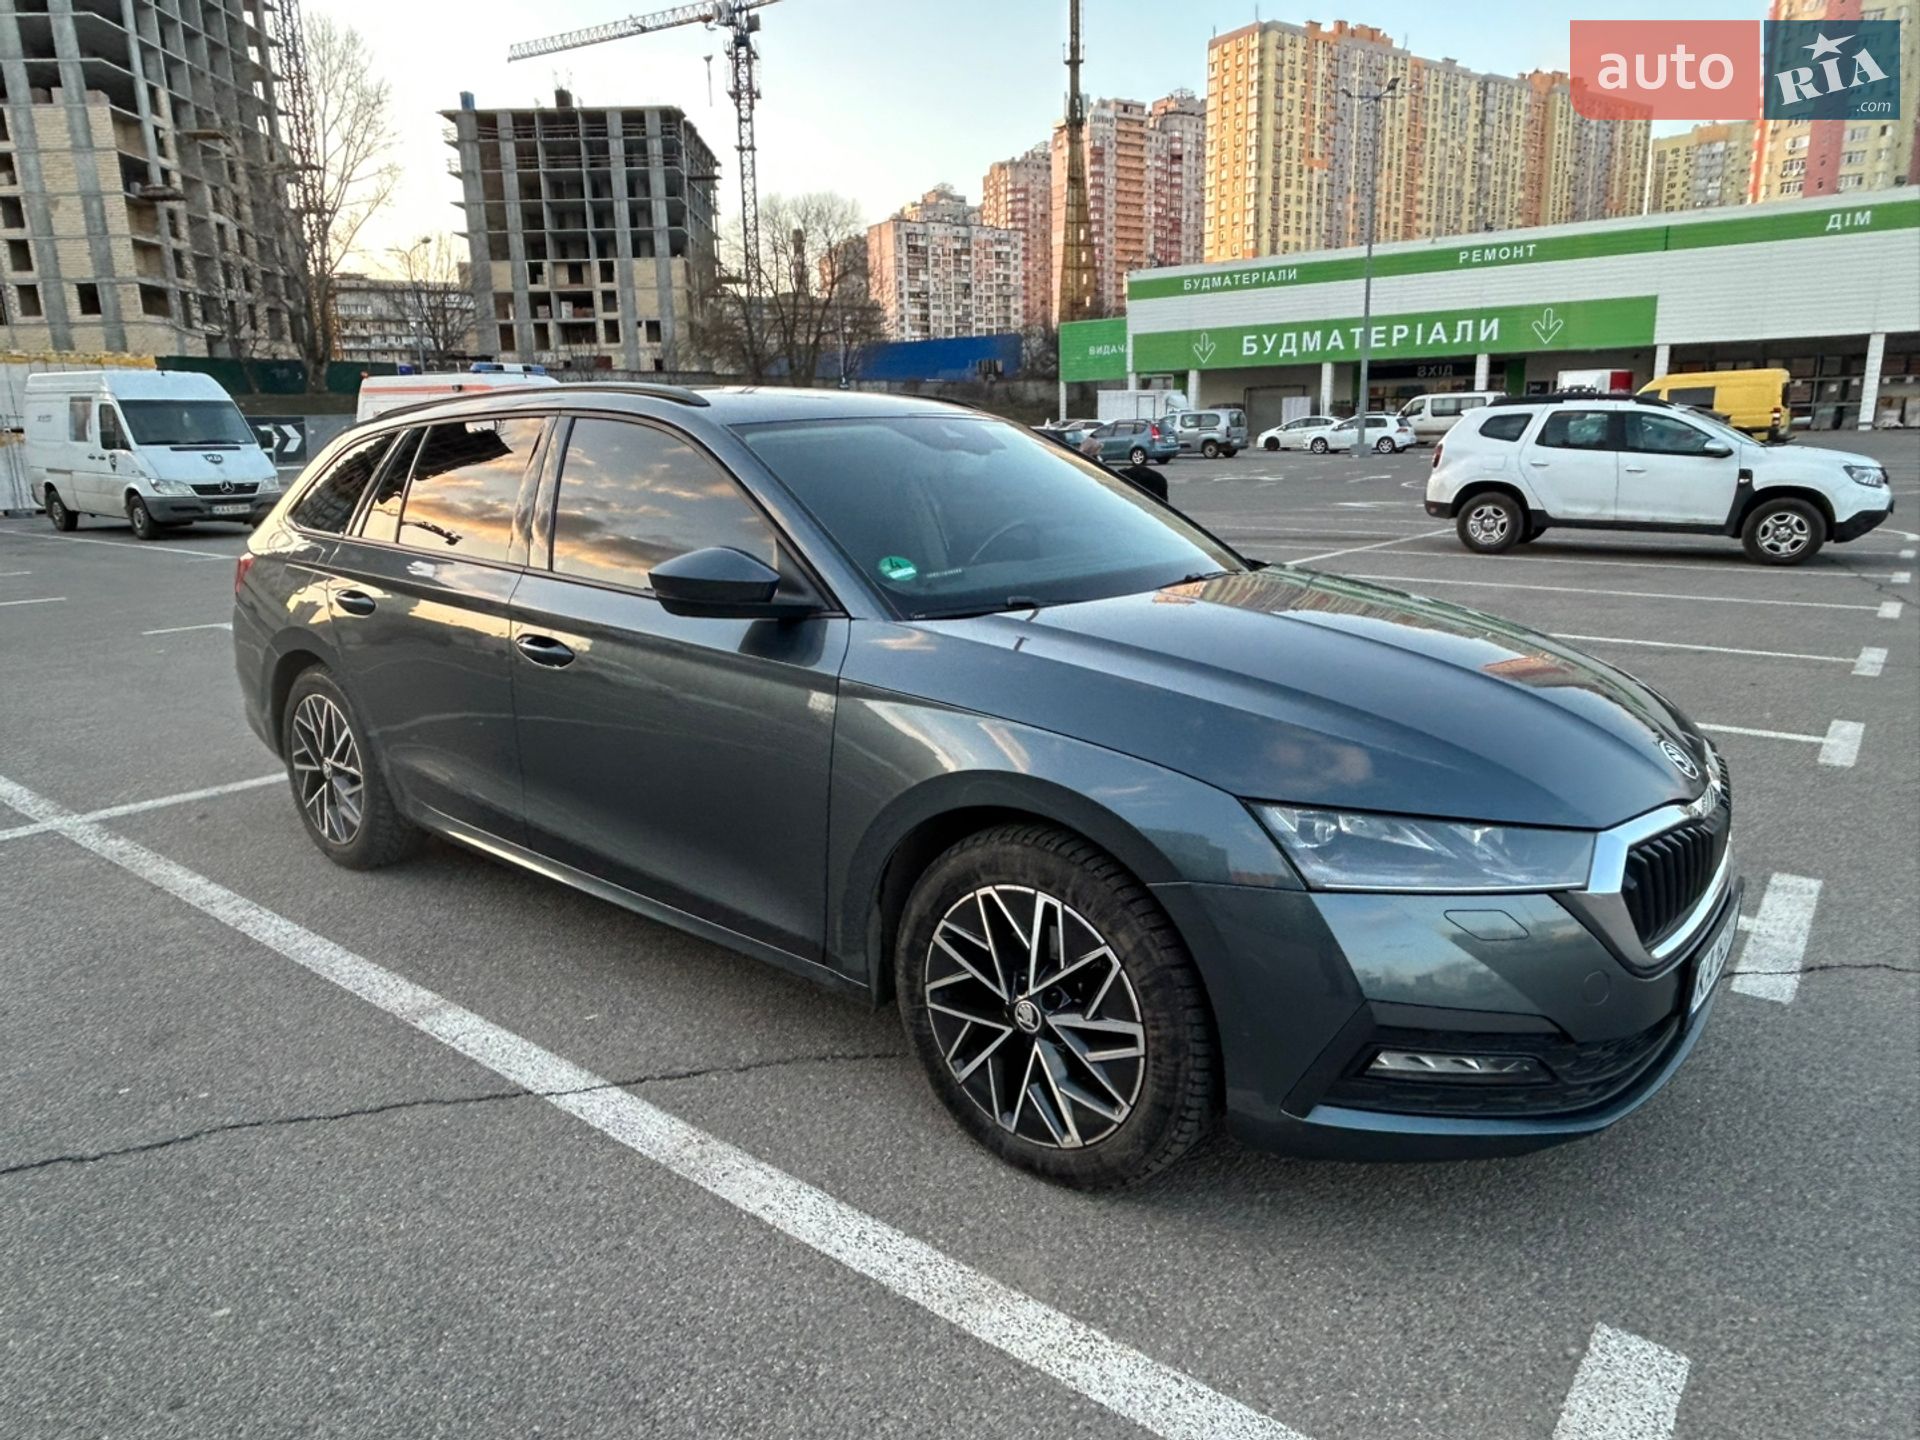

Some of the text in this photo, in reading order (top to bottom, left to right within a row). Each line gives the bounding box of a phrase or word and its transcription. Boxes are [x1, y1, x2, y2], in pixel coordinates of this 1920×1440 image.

[1825, 209, 1872, 232] ДІМ
[1459, 244, 1538, 263] РЕМОНТ
[1183, 268, 1298, 290] БУДМАТЕРІАЛИ
[1242, 317, 1500, 358] БУДМАТЕРІАЛИ
[1088, 344, 1127, 356] ВИДАЧ
[1416, 364, 1453, 377] ВХІД
